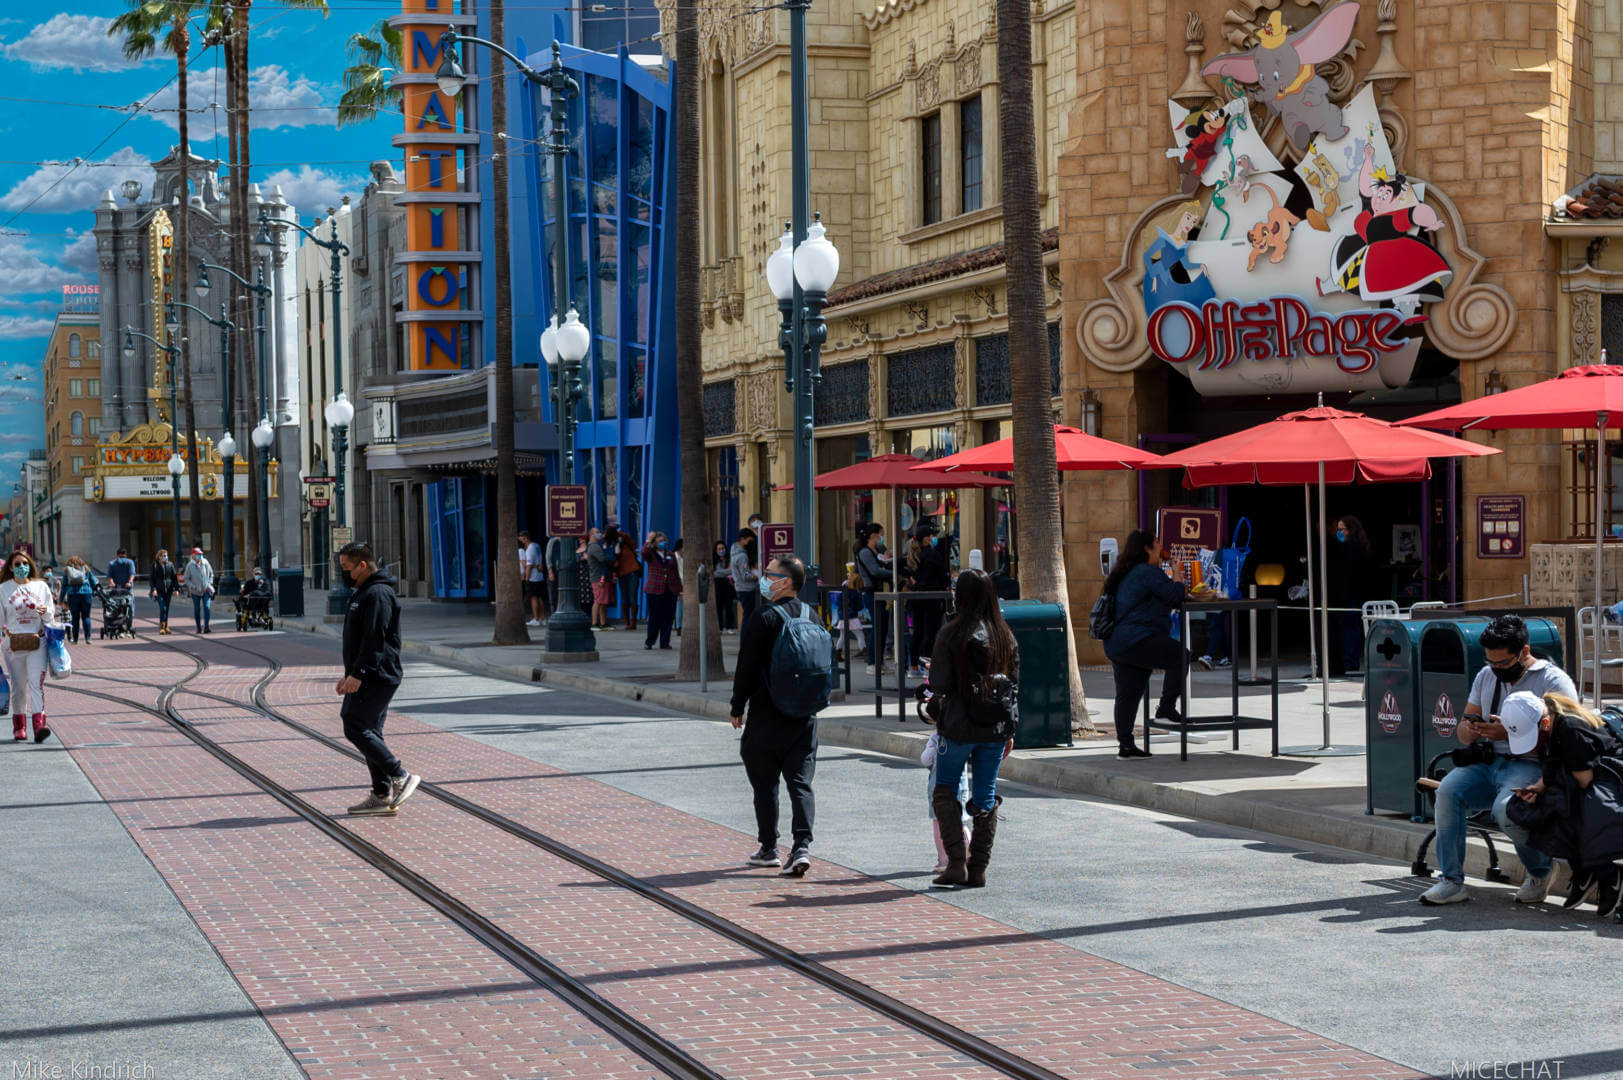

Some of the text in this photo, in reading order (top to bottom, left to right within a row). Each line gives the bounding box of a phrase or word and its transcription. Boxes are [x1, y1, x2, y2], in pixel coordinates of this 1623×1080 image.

[411, 0, 460, 366] MATION
[1147, 301, 1240, 372] Off
[1269, 297, 1409, 374] Page
[1378, 711, 1401, 722] HOLLYWOOD
[1433, 715, 1457, 726] HOLLYWOOD
